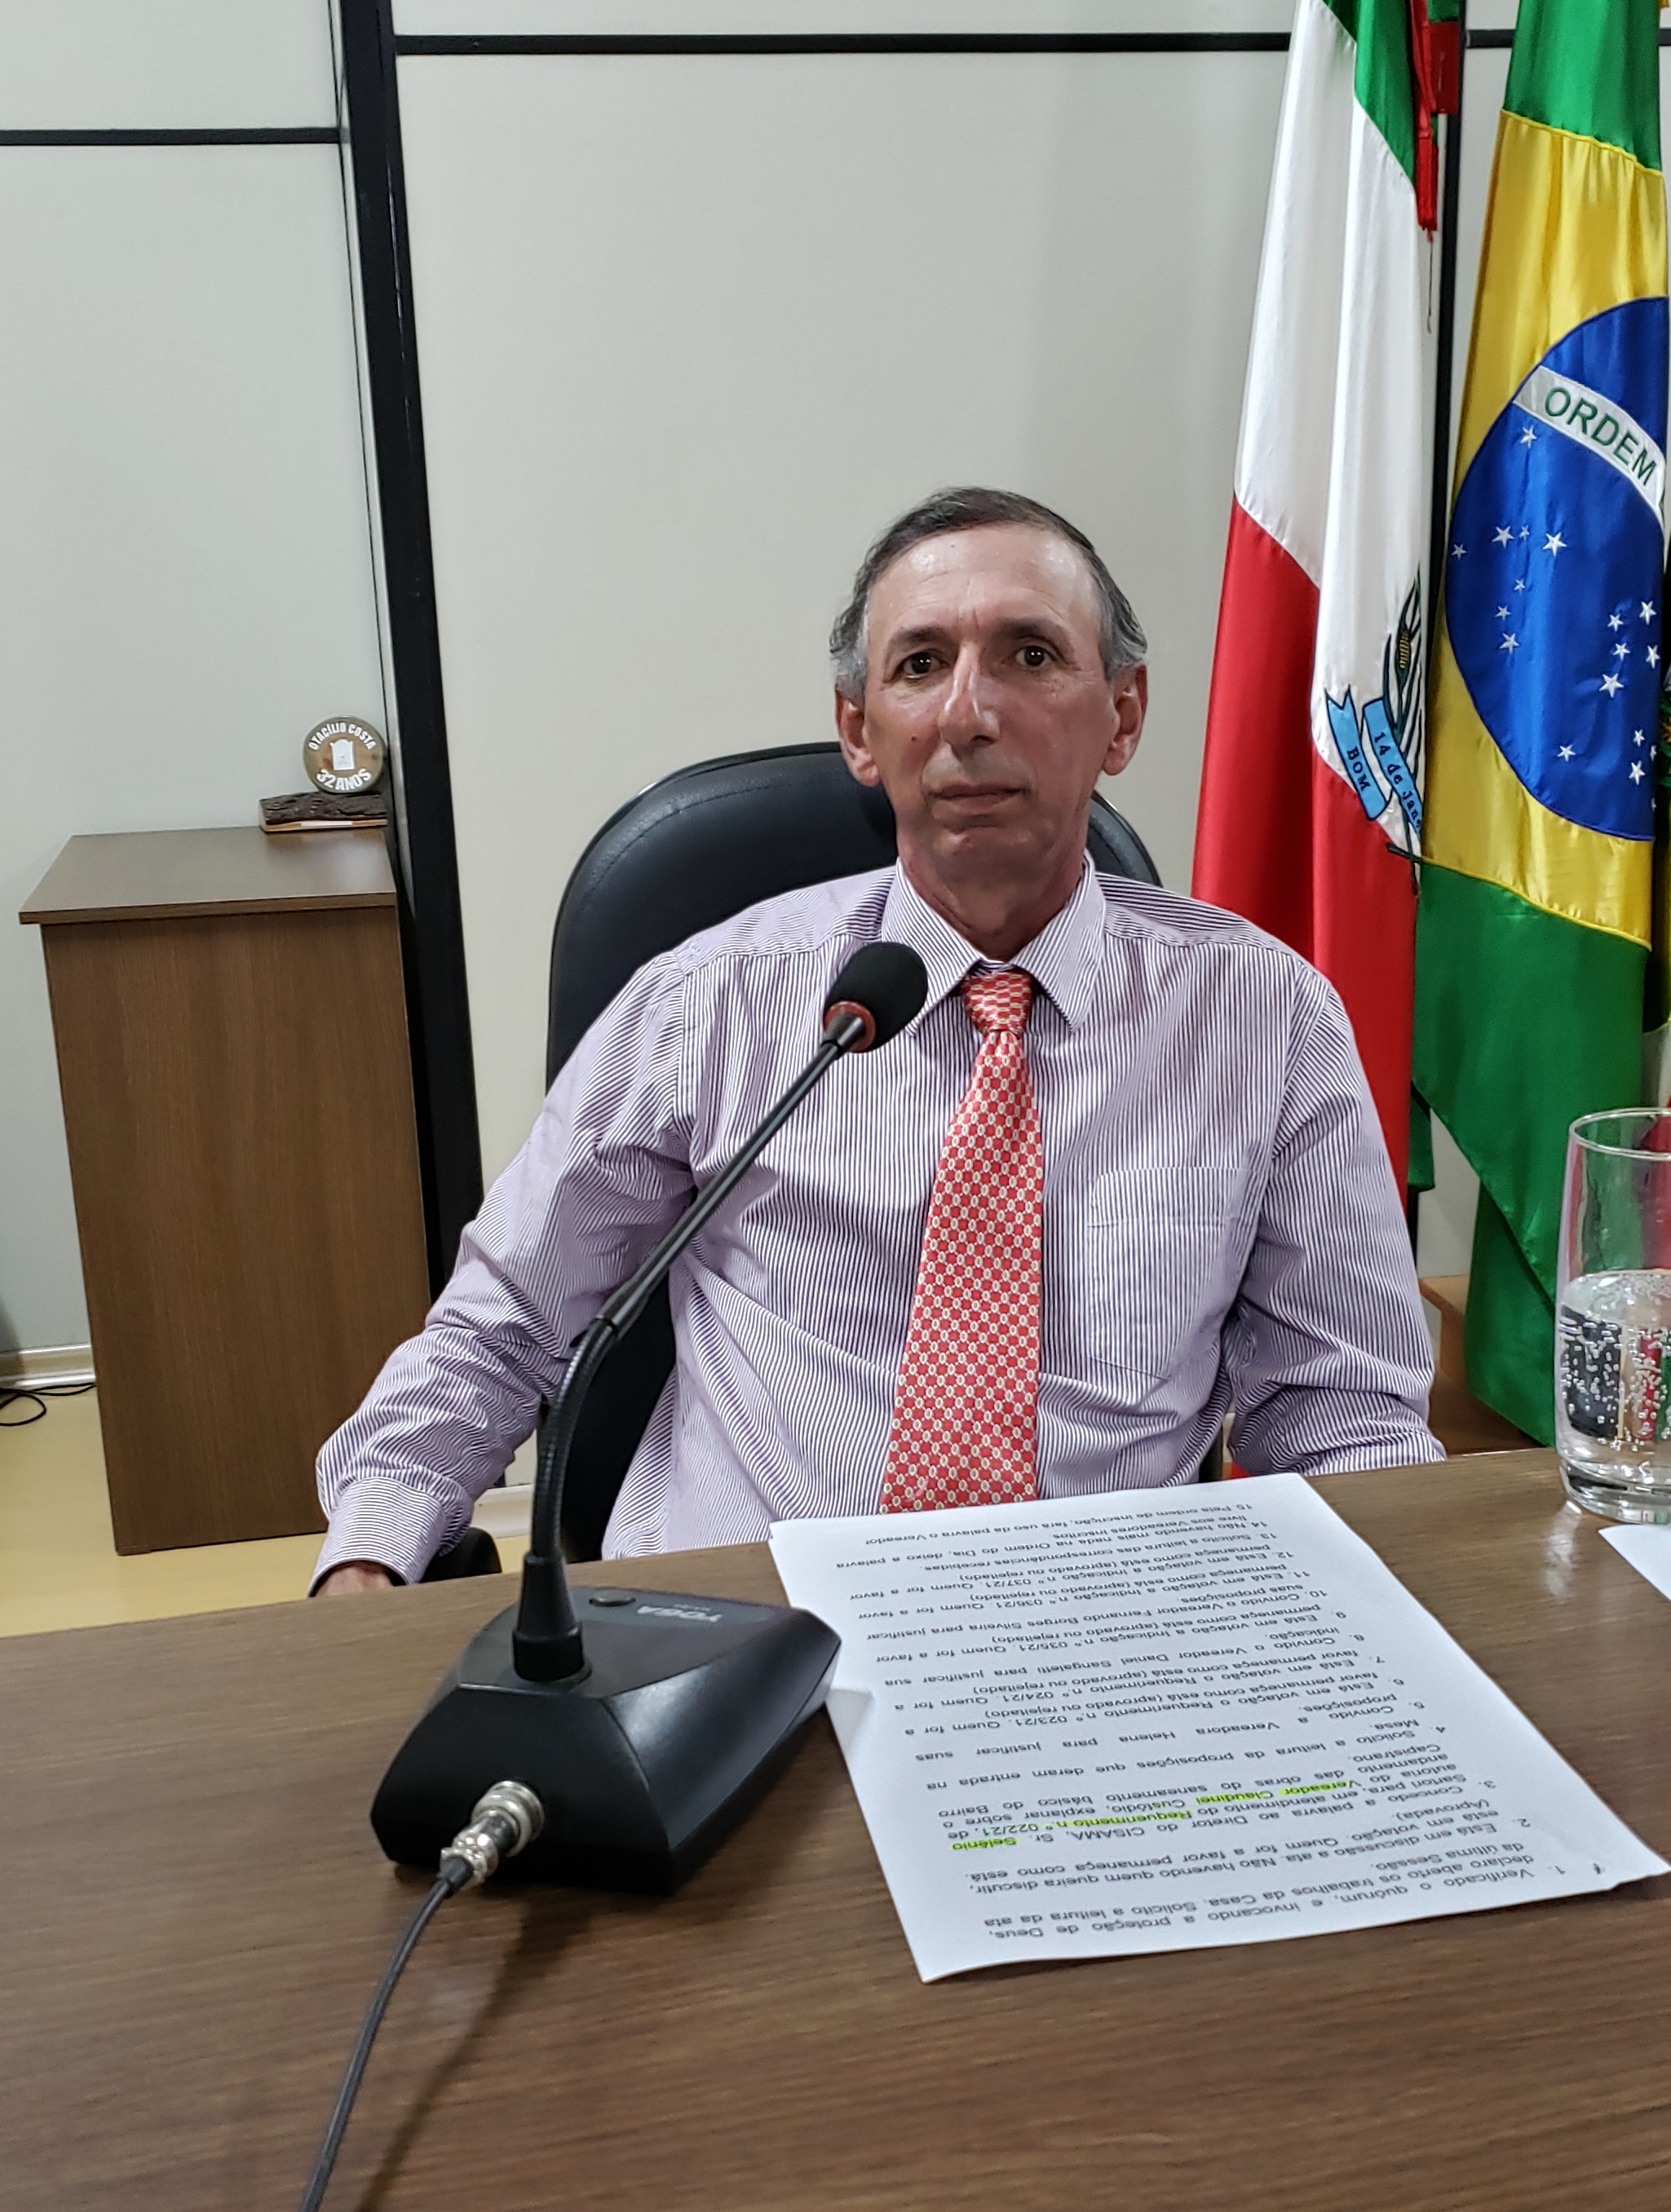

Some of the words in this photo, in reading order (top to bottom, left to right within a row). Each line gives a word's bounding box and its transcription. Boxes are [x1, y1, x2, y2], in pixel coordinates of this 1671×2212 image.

[1545, 387, 1657, 487] ORDEM
[347, 722, 377, 750] COSTA
[1373, 731, 1391, 757] 14
[1387, 763, 1404, 786] de
[1346, 745, 1372, 792] BOM
[316, 769, 335, 788] 32
[336, 768, 372, 791] ANOS
[1339, 1671, 1378, 1683] favor
[1249, 1676, 1336, 1693] permaneça
[1337, 1682, 1374, 1693] Está
[1166, 1692, 1200, 1702] está
[1203, 1688, 1246, 1698] como
[1237, 1691, 1300, 1705] votação
[1085, 1693, 1163, 1711] (aprovado
[1297, 1693, 1398, 1712] proposições.
[984, 1705, 1059, 1720] rejeitado)
[1103, 1701, 1213, 1718] Requerimento
[1328, 1706, 1395, 1720] Convido
[924, 1725, 945, 1734] for
[952, 1720, 1001, 1731] Quem
[1195, 1722, 1280, 1735] Vereadora
[1368, 1719, 1420, 1731] Mesa.
[1062, 1737, 1099, 1748] para
[1118, 1731, 1177, 1742] Helena
[1355, 1730, 1416, 1744] Solicito
[975, 1741, 1042, 1755] justificar
[1275, 1742, 1327, 1755] leitura
[1346, 1743, 1441, 1763] Capistrano.
[915, 1751, 954, 1761] suas
[1136, 1751, 1235, 1768] proposições
[1095, 1763, 1126, 1773] que
[1357, 1754, 1449, 1773] andamento
[1399, 1764, 1457, 1777] autoria
[958, 1773, 1021, 1786] entrada
[1032, 1768, 1085, 1777] deram
[1313, 1769, 1345, 1781] das
[1254, 1776, 1302, 1787] obras
[1284, 1779, 1363, 1795] Vereador
[1361, 1781, 1407, 1794] para,
[1410, 1774, 1467, 1789] Sartori
[1037, 1795, 1094, 1807] básico
[1105, 1785, 1208, 1803] saneamento
[1195, 1790, 1275, 1806] Claudinei
[1387, 1786, 1464, 1803] Concedo
[938, 1804, 989, 1817] Bairro
[1105, 1799, 1186, 1814] Custódio,
[1223, 1795, 1326, 1813] atendimento
[1291, 1800, 1355, 1817] palavra
[1390, 1799, 1490, 1821] (Aprovada).
[965, 1813, 1013, 1826] sobre
[1023, 1806, 1096, 1819] explanar
[1072, 1807, 1193, 1828] Requerimento
[1461, 1810, 1499, 1822] está
[1191, 1815, 1249, 1828] Diretor
[1065, 1826, 1146, 1841] CISAMA,
[1456, 1822, 1497, 1836] Está
[1028, 1833, 1054, 1843] Sr.
[1284, 1837, 1339, 1850] Quem
[1255, 1844, 1279, 1854] for
[1333, 1836, 1421, 1857] discussão
[1444, 1845, 1499, 1859] última
[1074, 1854, 1173, 1871] permaneça
[1183, 1850, 1227, 1863] favor
[1239, 1857, 1277, 1868] Não
[1368, 1854, 1443, 1870] Sessão.
[1470, 1854, 1534, 1869] declaro
[964, 1870, 1009, 1883] está.
[1017, 1865, 1066, 1877] como
[1104, 1870, 1155, 1882] quem
[1159, 1861, 1236, 1879] havendo
[1407, 1863, 1463, 1879] aberto
[1043, 1874, 1099, 1887] queira
[1443, 1869, 1535, 1887] Verificado
[970, 1880, 1039, 1894] discutir,
[1290, 1878, 1375, 1896] trabalhos
[1333, 1885, 1408, 1903] quórum,
[1050, 1909, 1107, 1921] leitura
[1130, 1901, 1197, 1915] Solicito
[1207, 1901, 1301, 1922] invocando
[984, 1917, 1013, 1927] ata
[1091, 1915, 1172, 1932] proteção
[988, 1927, 1044, 1939] Deus,
